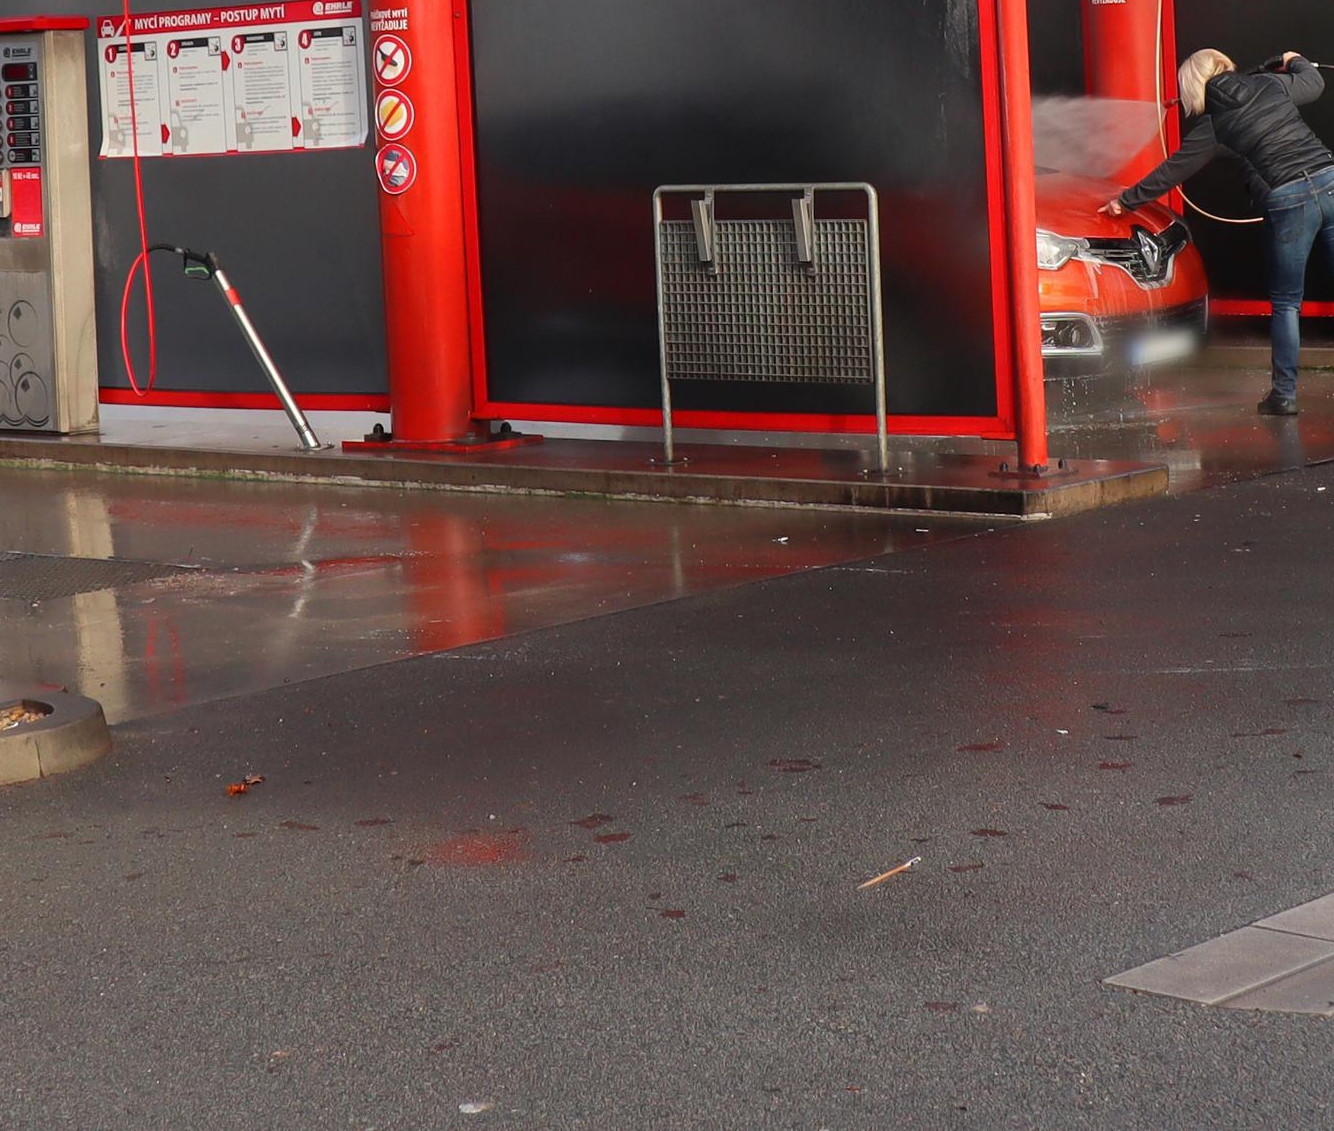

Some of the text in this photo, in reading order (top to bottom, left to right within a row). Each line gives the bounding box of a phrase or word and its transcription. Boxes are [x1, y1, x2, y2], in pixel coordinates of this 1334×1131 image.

[134, 14, 158, 30] MYCÍ
[158, 12, 212, 28] PROGRAMY
[220, 8, 259, 23] POSTUP
[260, 3, 285, 20] MYTÍ
[392, 7, 408, 18] MYTÍ
[234, 37, 241, 51] 3
[301, 32, 308, 46] 4
[170, 42, 177, 57] 2
